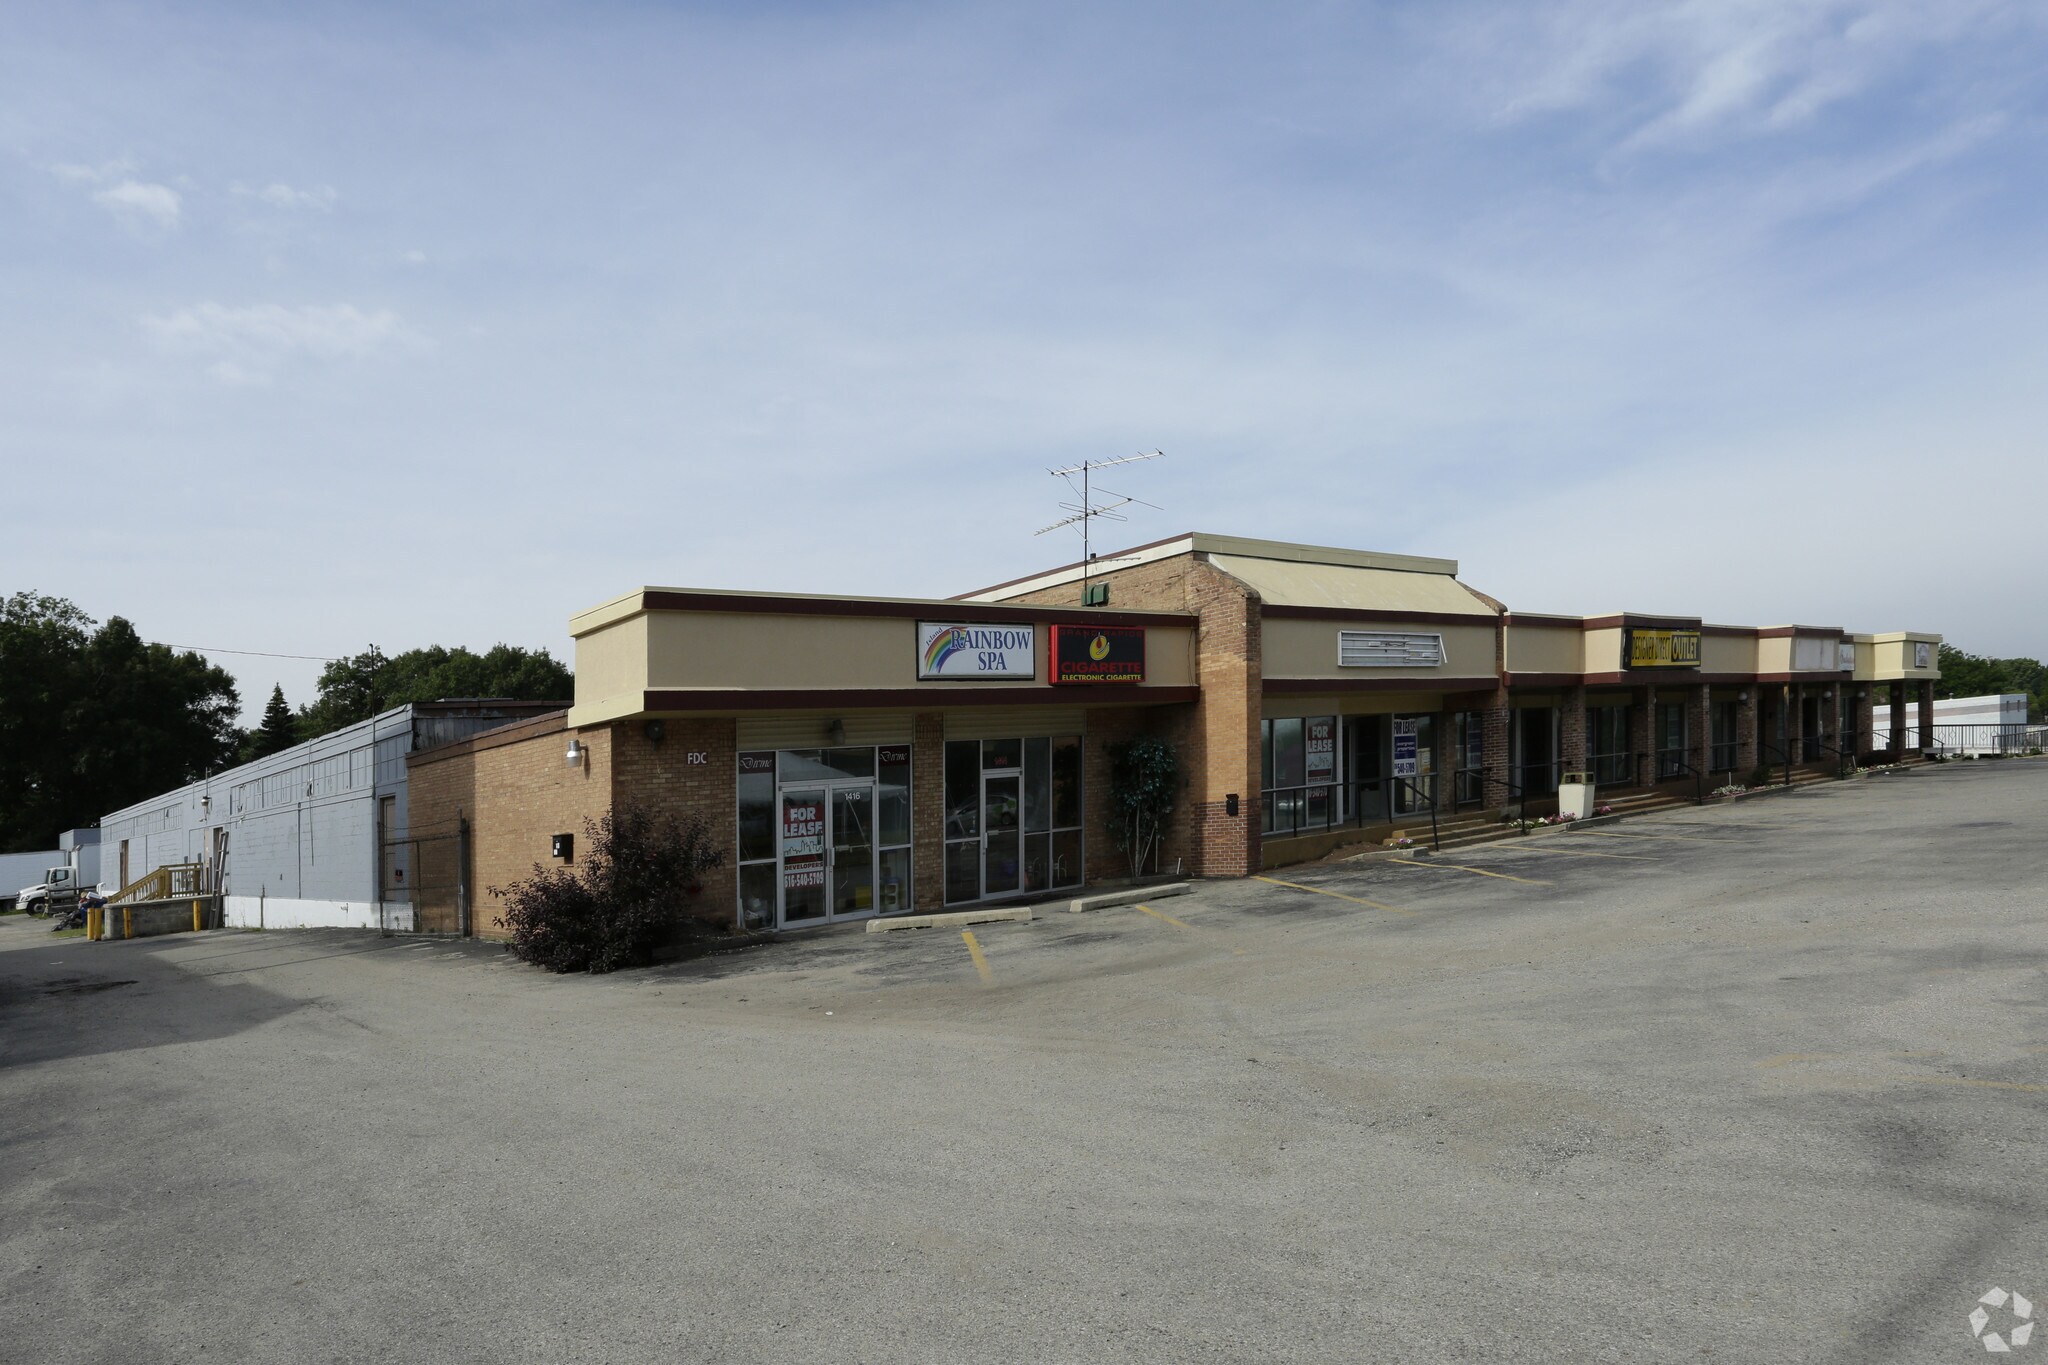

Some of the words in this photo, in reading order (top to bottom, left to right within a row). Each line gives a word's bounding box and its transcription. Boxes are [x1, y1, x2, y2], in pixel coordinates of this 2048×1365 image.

[926, 627, 943, 645] Island
[950, 629, 1030, 650] RAINBOW
[1672, 636, 1697, 660] OUTLET
[978, 651, 1007, 671] SPA
[1061, 661, 1141, 673] CIGARETTE
[1312, 726, 1328, 739] FOR
[1394, 721, 1402, 735] FOR
[1403, 721, 1415, 734] LEASE
[1308, 739, 1333, 753] LEASE
[687, 751, 707, 765] FDC
[739, 757, 772, 769] Divine
[879, 751, 907, 762] Divine
[845, 792, 861, 800] 1416
[790, 807, 816, 822] FOR
[784, 822, 823, 837] LEASE
[784, 862, 823, 871] DEVELOPERS
